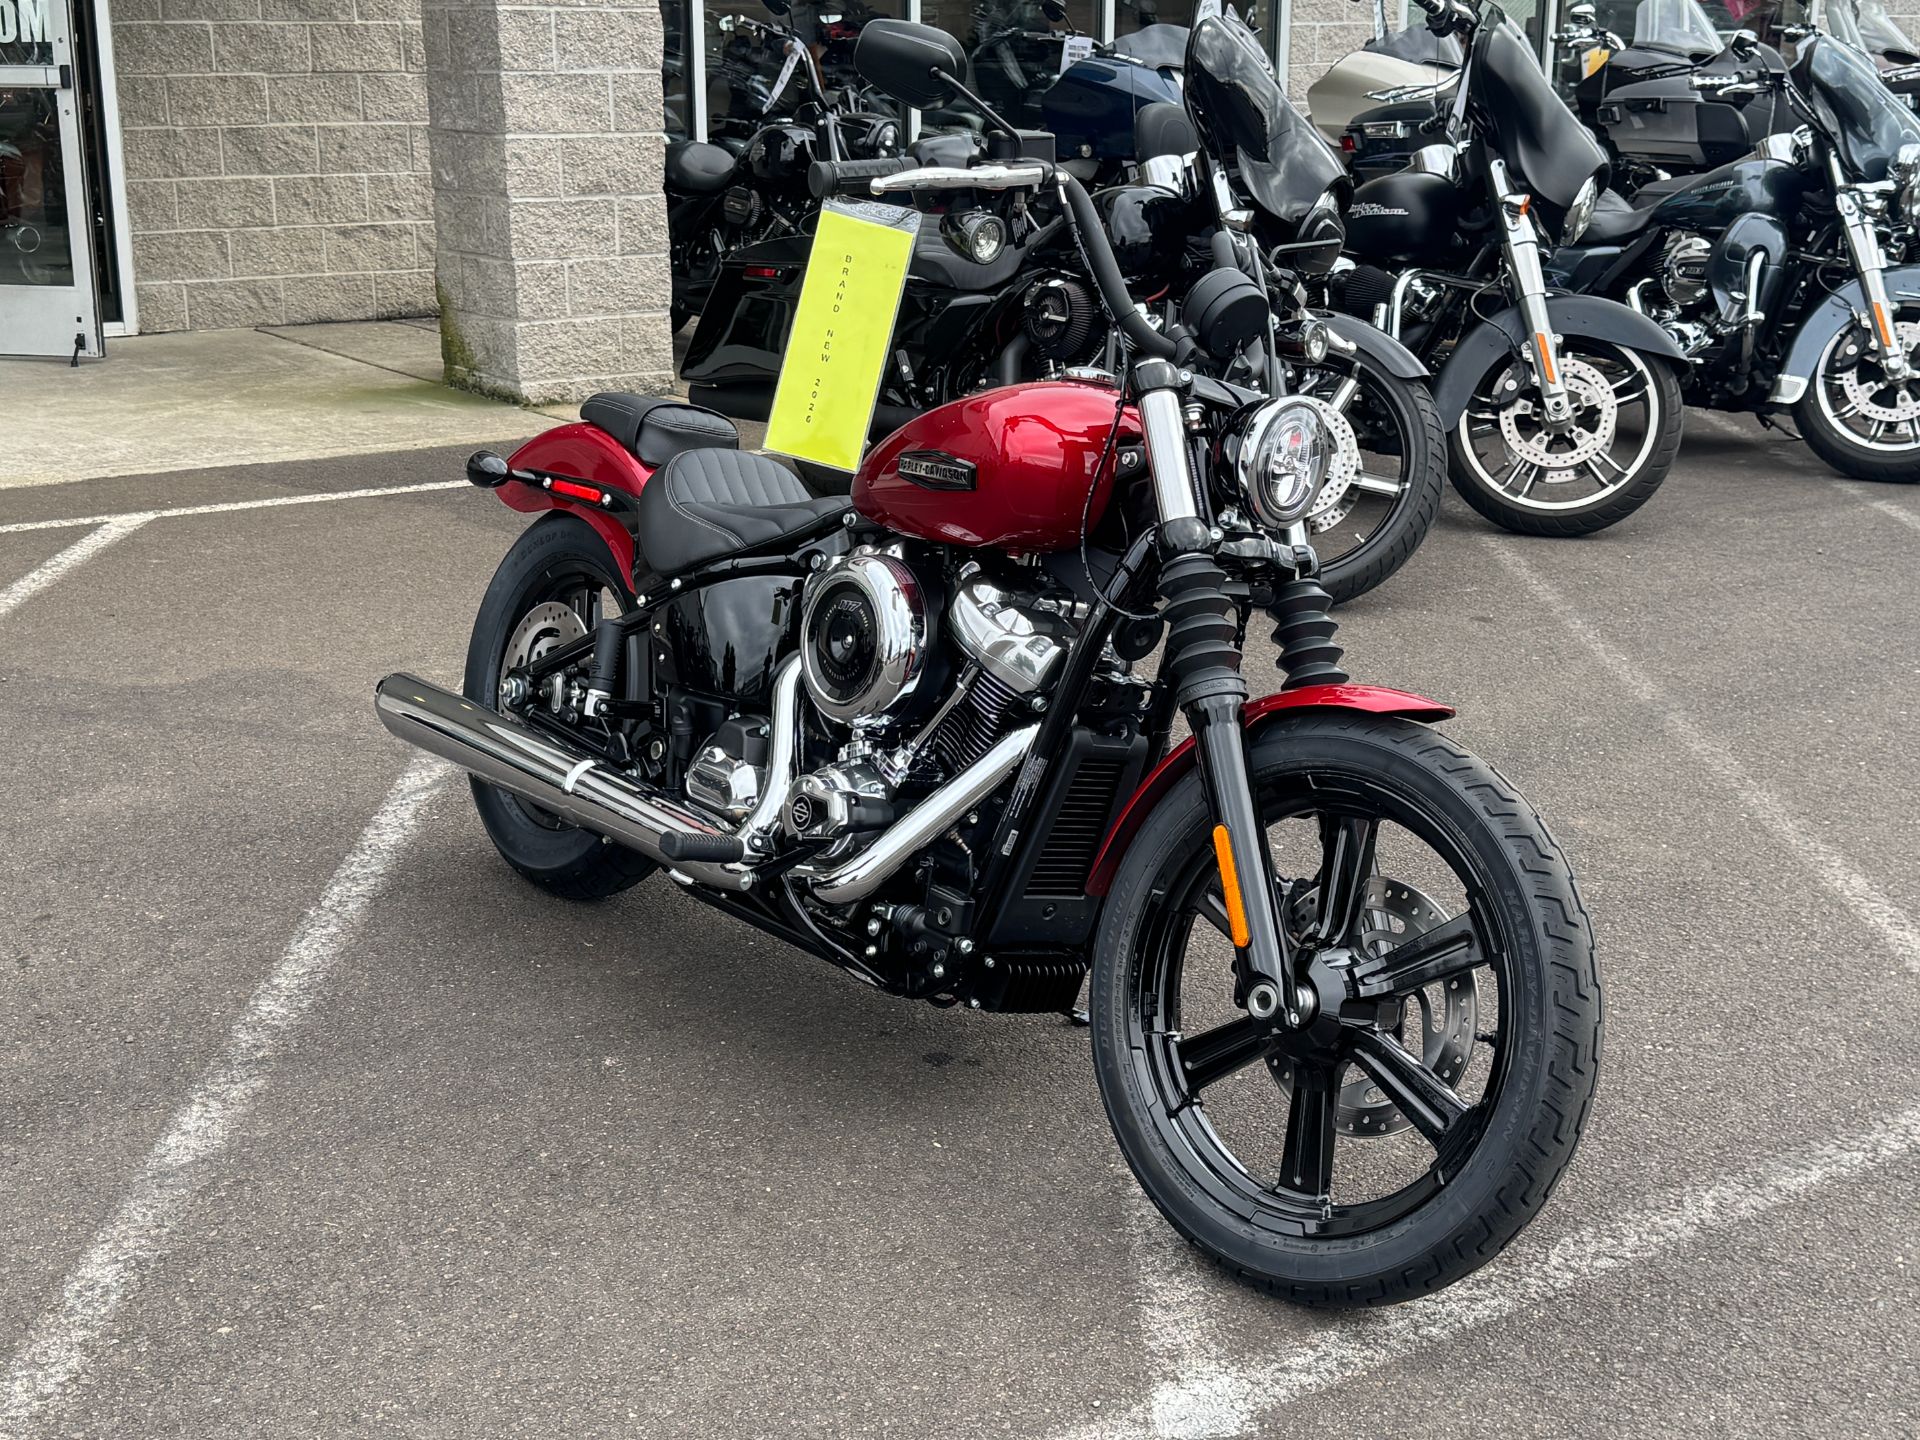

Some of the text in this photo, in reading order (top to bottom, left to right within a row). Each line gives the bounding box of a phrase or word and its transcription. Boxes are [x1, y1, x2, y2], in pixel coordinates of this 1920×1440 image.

[805, 254, 852, 423] BRAND NEW 2026
[839, 599, 862, 612] 117
